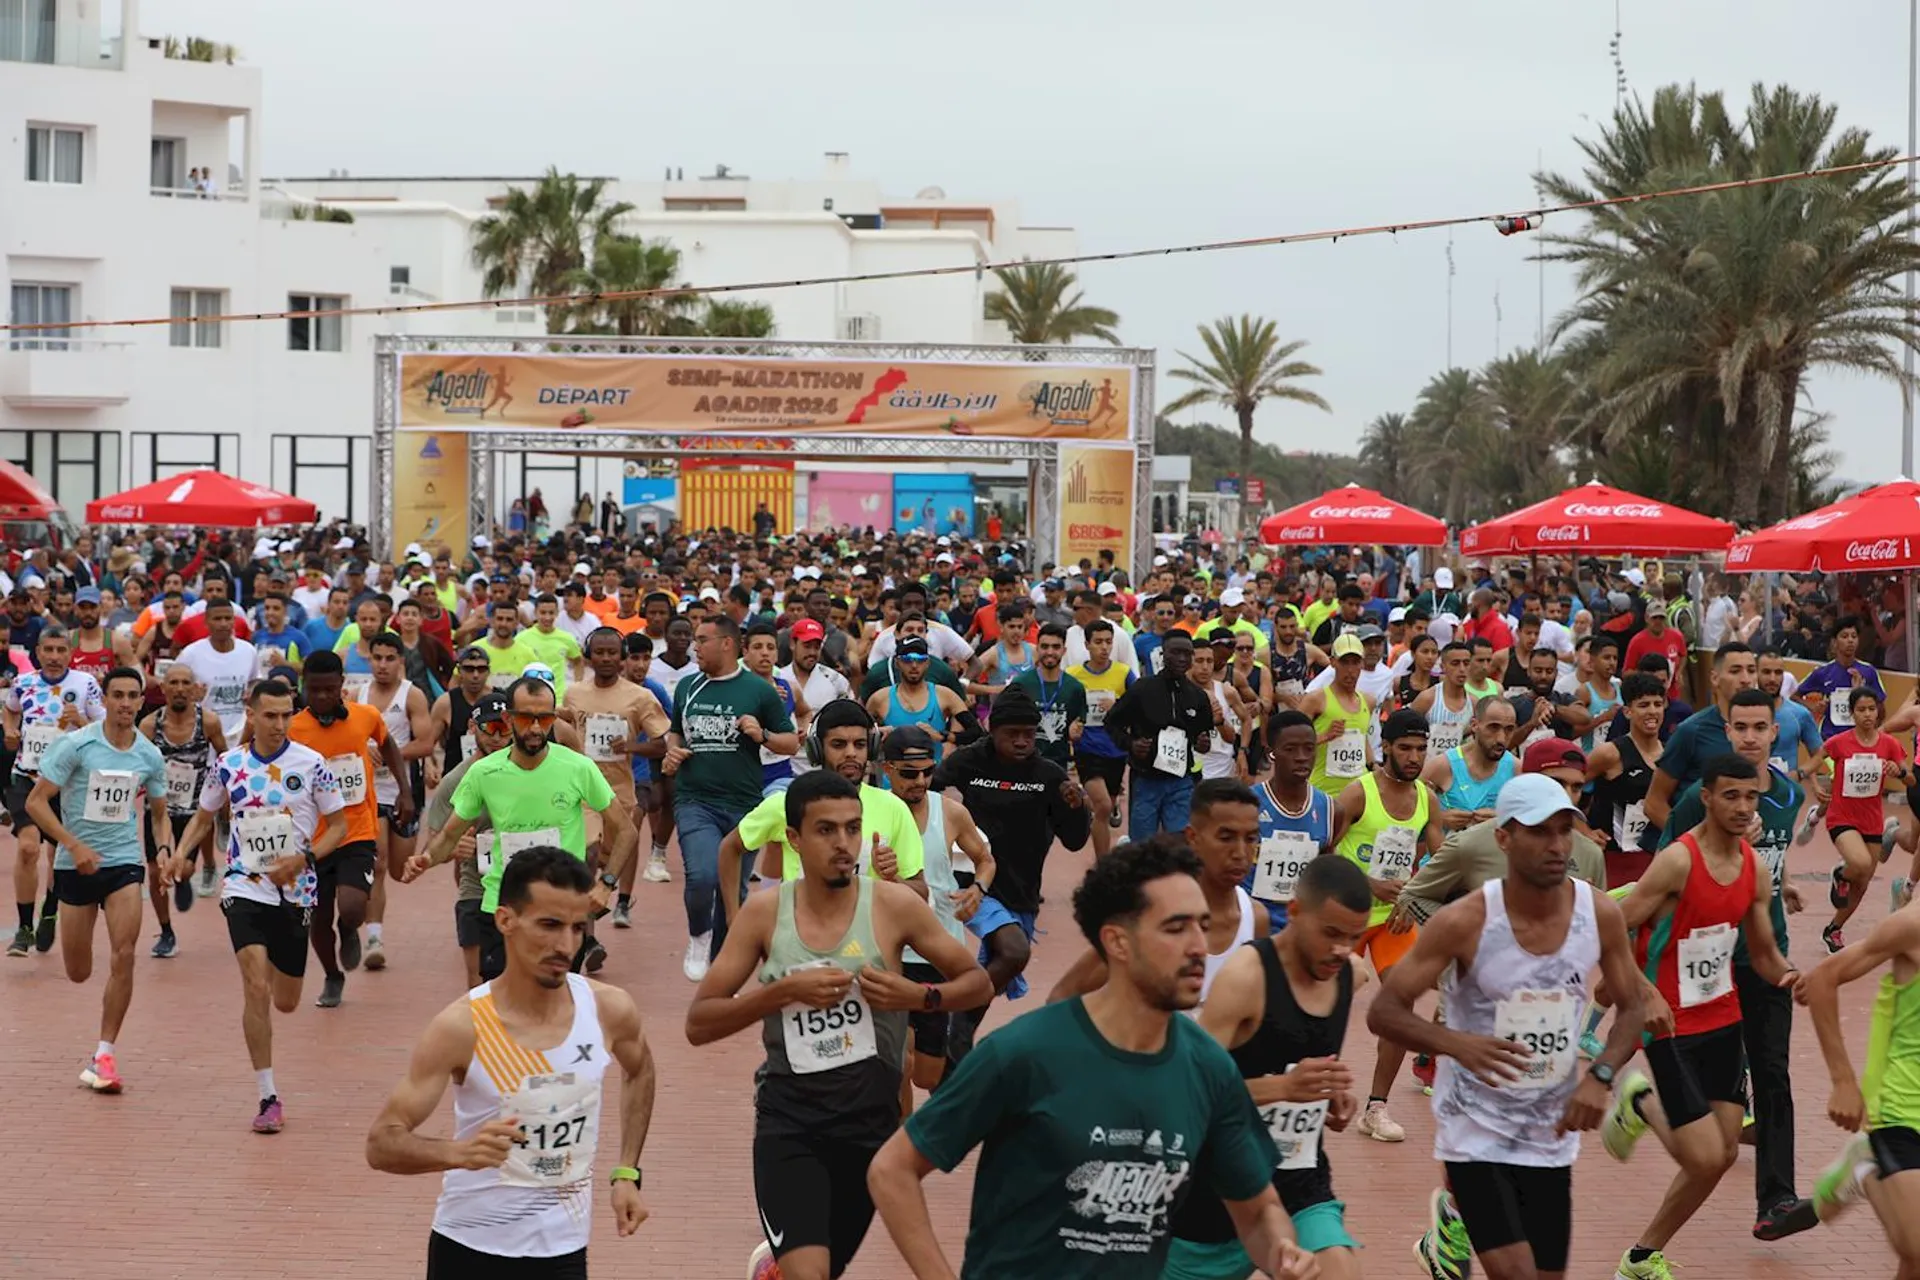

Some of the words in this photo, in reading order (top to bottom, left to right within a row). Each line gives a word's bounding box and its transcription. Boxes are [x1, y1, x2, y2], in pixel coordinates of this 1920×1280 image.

[427, 368, 489, 406] Agadir
[667, 368, 865, 391] SEMI-MARATHON
[693, 395, 784, 413] AGADIR
[783, 397, 840, 415] 2024
[1034, 379, 1095, 418] Agadir
[1162, 745, 1186, 761] 1212
[1431, 738, 1459, 749] 1233
[1332, 749, 1363, 762] 1049
[969, 777, 1000, 789] JACK
[1010, 782, 1045, 792] JONES
[1849, 771, 1880, 783] 1225
[93, 787, 131, 803] 1101
[246, 834, 288, 853] 1017
[1378, 850, 1412, 867] 1765
[792, 999, 863, 1037] 1559
[1262, 1107, 1322, 1133] 4162
[511, 1115, 587, 1150] 4127
